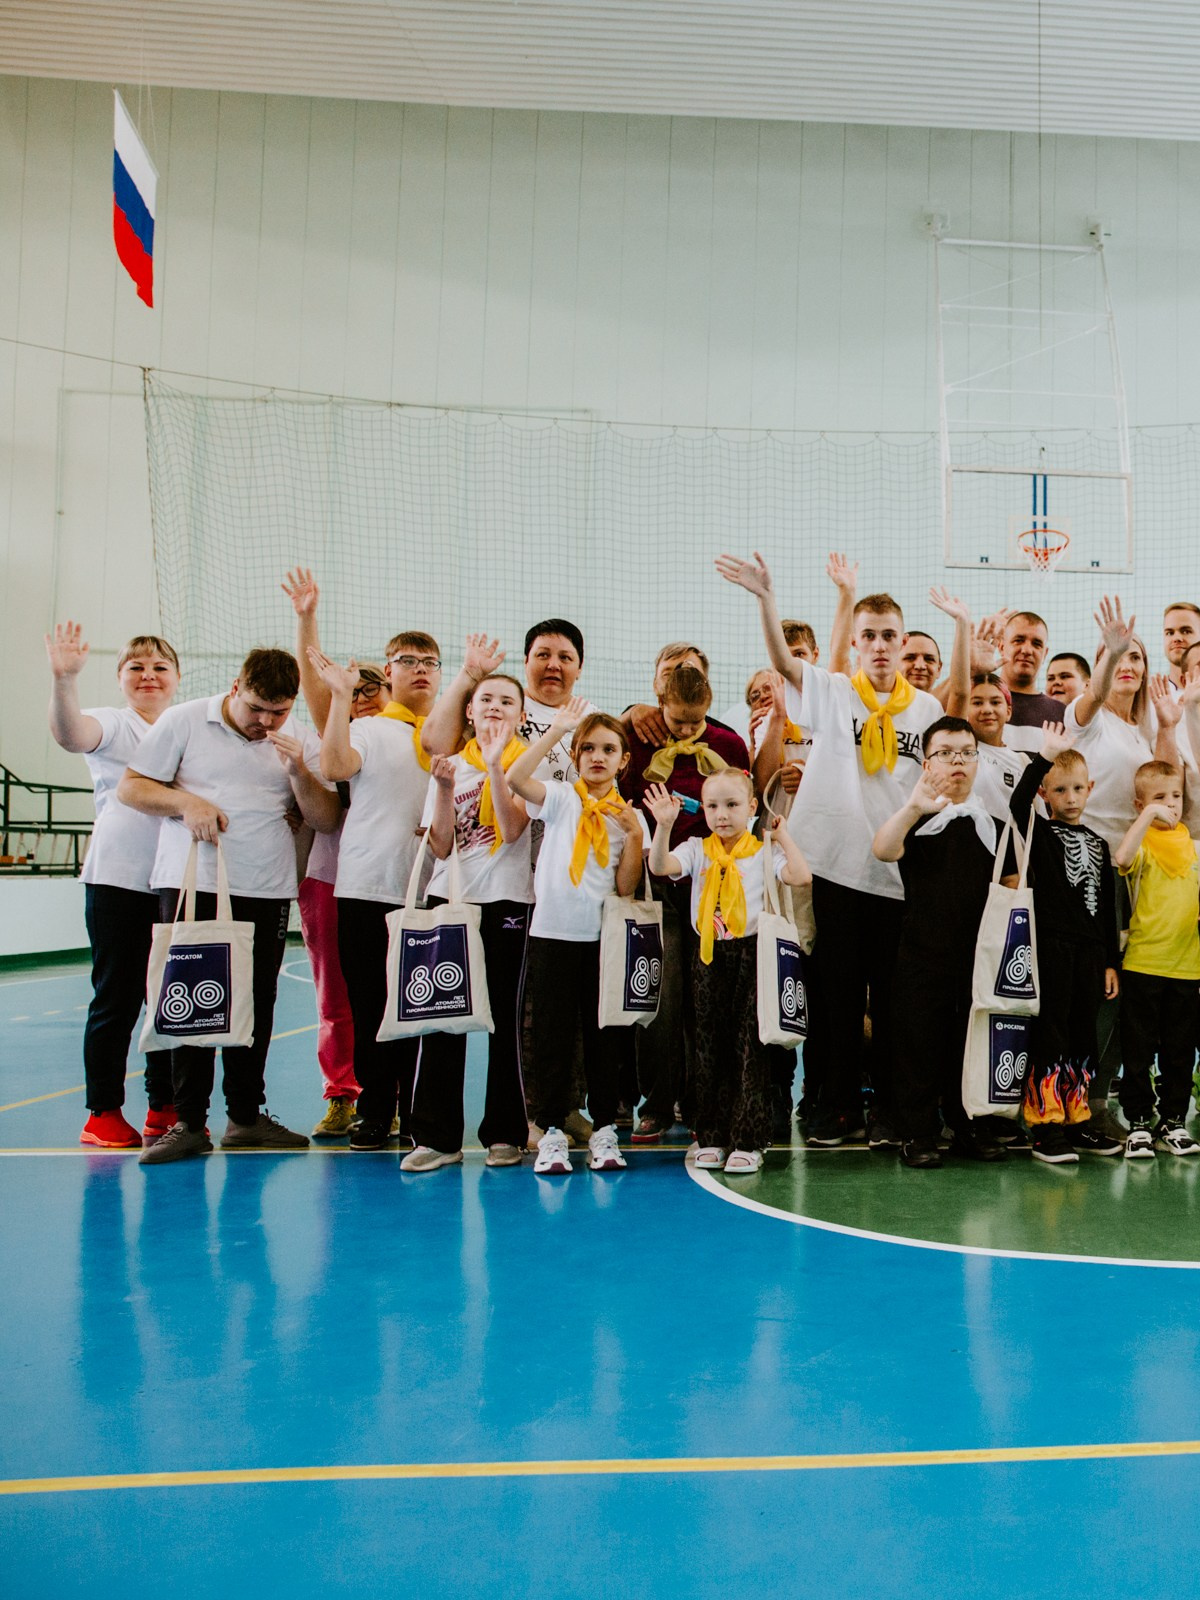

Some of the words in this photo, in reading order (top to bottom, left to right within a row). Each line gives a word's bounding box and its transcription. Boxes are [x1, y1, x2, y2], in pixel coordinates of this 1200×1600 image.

[405, 961, 464, 1006] 80
[630, 956, 661, 997] 80
[781, 976, 805, 1018] 80
[161, 980, 225, 1022] 80
